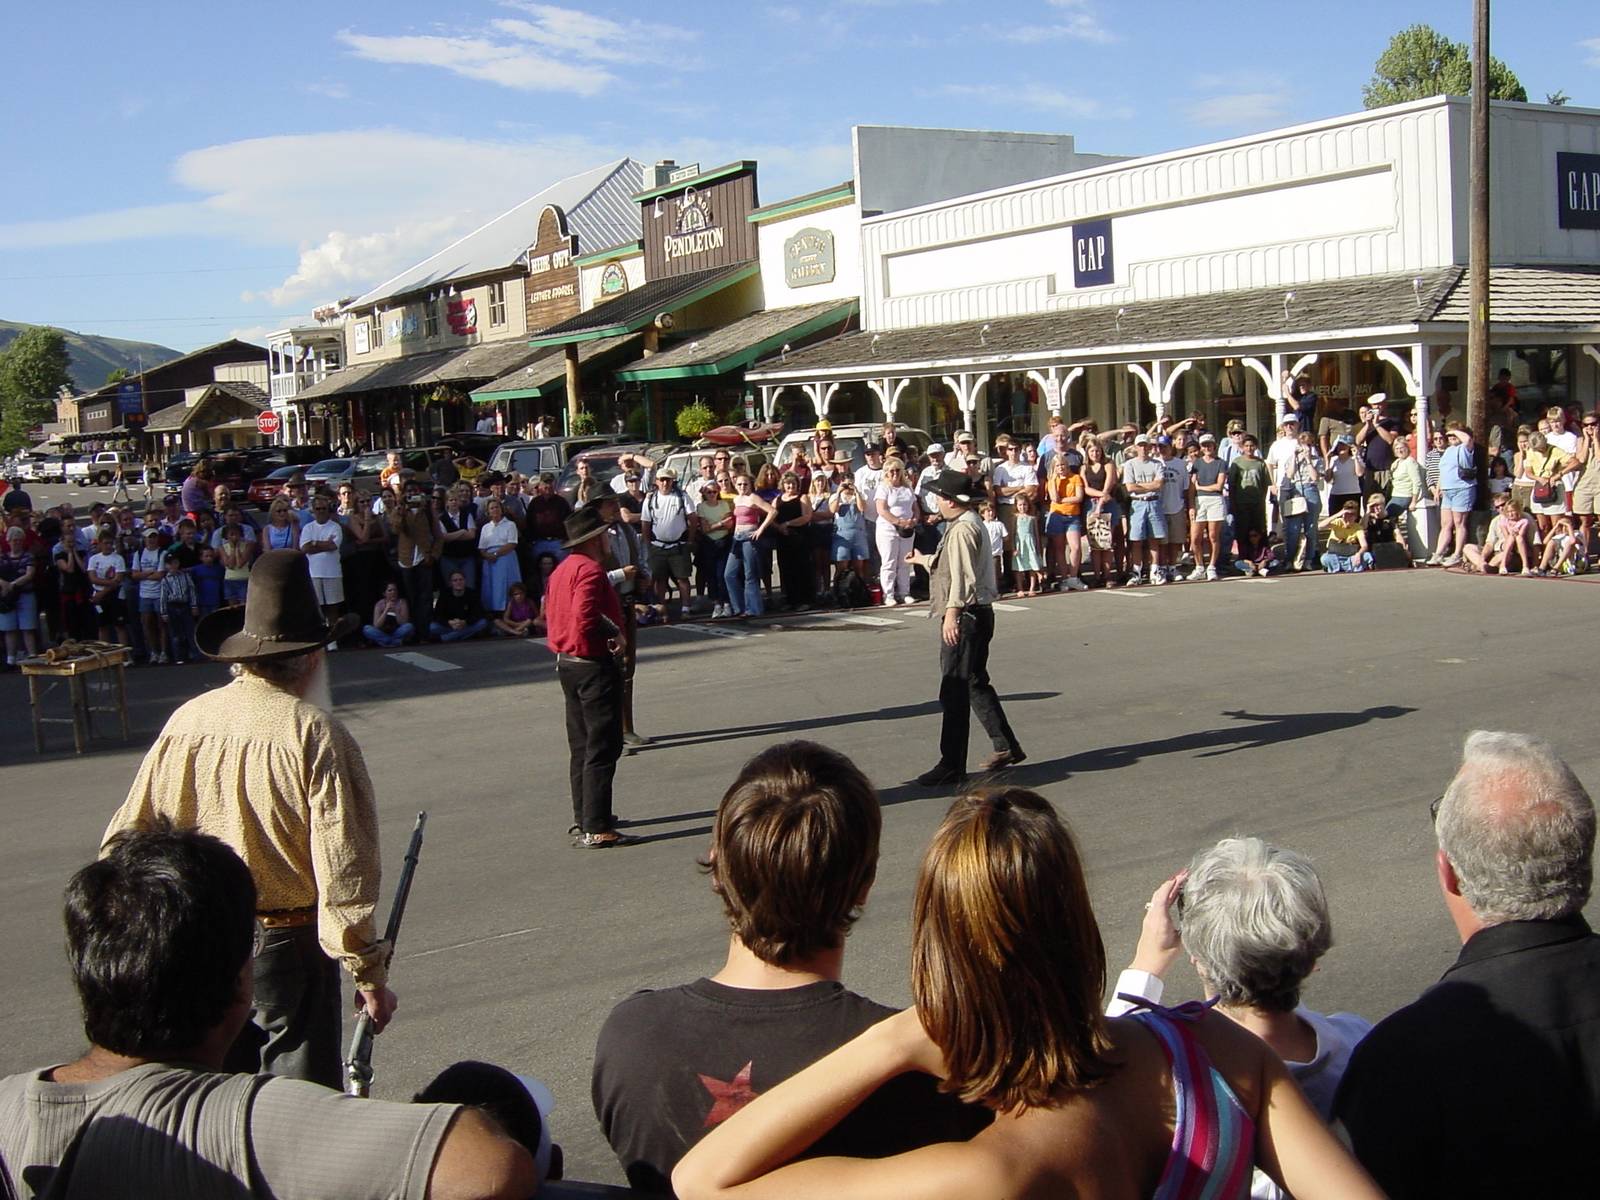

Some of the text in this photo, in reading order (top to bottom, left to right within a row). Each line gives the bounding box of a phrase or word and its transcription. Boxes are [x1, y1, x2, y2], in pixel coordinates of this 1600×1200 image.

[1568, 170, 1600, 211] GAP
[552, 249, 569, 270] OUT
[663, 227, 724, 262] PENDLETON
[1077, 235, 1106, 272] GAP
[260, 417, 278, 428] STOP
